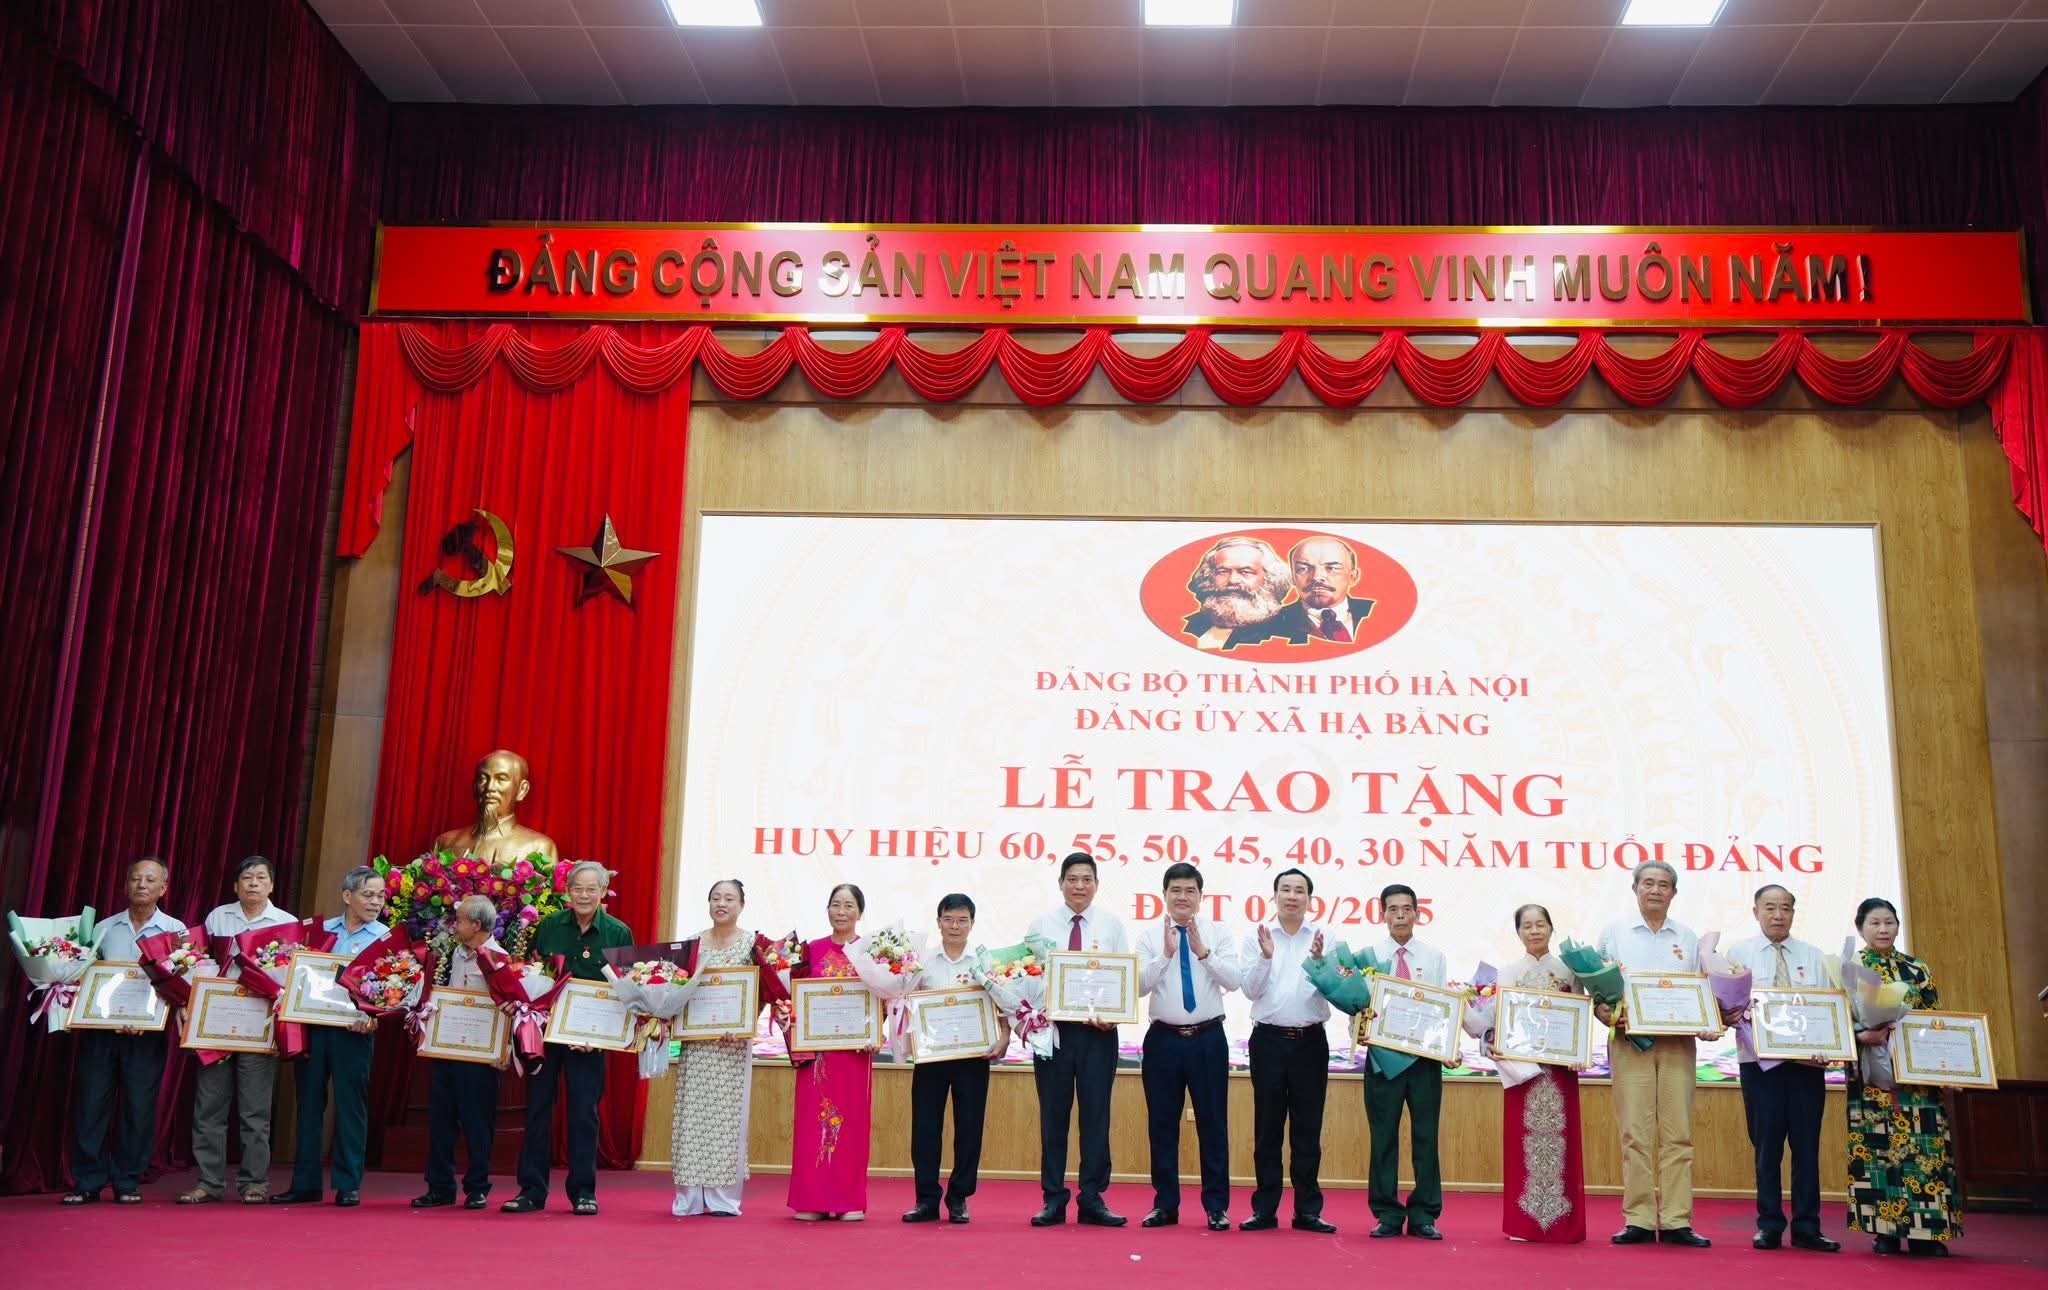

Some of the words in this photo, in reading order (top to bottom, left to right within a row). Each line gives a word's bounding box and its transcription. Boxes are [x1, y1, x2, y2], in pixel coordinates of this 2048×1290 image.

[488, 232, 637, 296] ĐẢNG
[653, 237, 803, 308] CỘNG
[820, 232, 925, 297] SẢN
[938, 239, 1056, 308] VIỆT
[1071, 252, 1186, 299] NAM
[1203, 253, 1396, 302] QUANG
[1408, 254, 1535, 301] VINH
[1552, 241, 1711, 302] MUÔN
[1034, 665, 1131, 692] ĐẢNG
[1142, 670, 1188, 698] BỘ
[1197, 667, 1317, 695] THÀNH
[1328, 669, 1400, 696] PHỐ
[1410, 670, 1458, 696] HÀ
[1468, 674, 1529, 703] NỘI
[1074, 702, 1183, 732] ĐẢNG
[1195, 703, 1245, 732] ỦY
[1255, 706, 1307, 733] XÃ
[1319, 712, 1373, 740] HẠ
[1384, 706, 1491, 736] BẰNG
[999, 753, 1095, 810] LỄ
[1116, 769, 1331, 813] TRAO
[1351, 765, 1568, 828] TẶNG
[753, 827, 854, 857] HUY
[866, 826, 983, 866] HIỆU
[1000, 832, 1056, 867] 60,
[1071, 833, 1129, 867] 55,
[1142, 834, 1201, 867] 50,
[1213, 836, 1273, 869] 45,
[1285, 836, 1345, 871] 40,
[1358, 837, 1404, 867] 30
[1420, 832, 1530, 868] NĂM
[1544, 834, 1665, 871] TUỔI
[1681, 835, 1825, 874] ĐẢNG
[1131, 893, 1232, 922] ĐT
